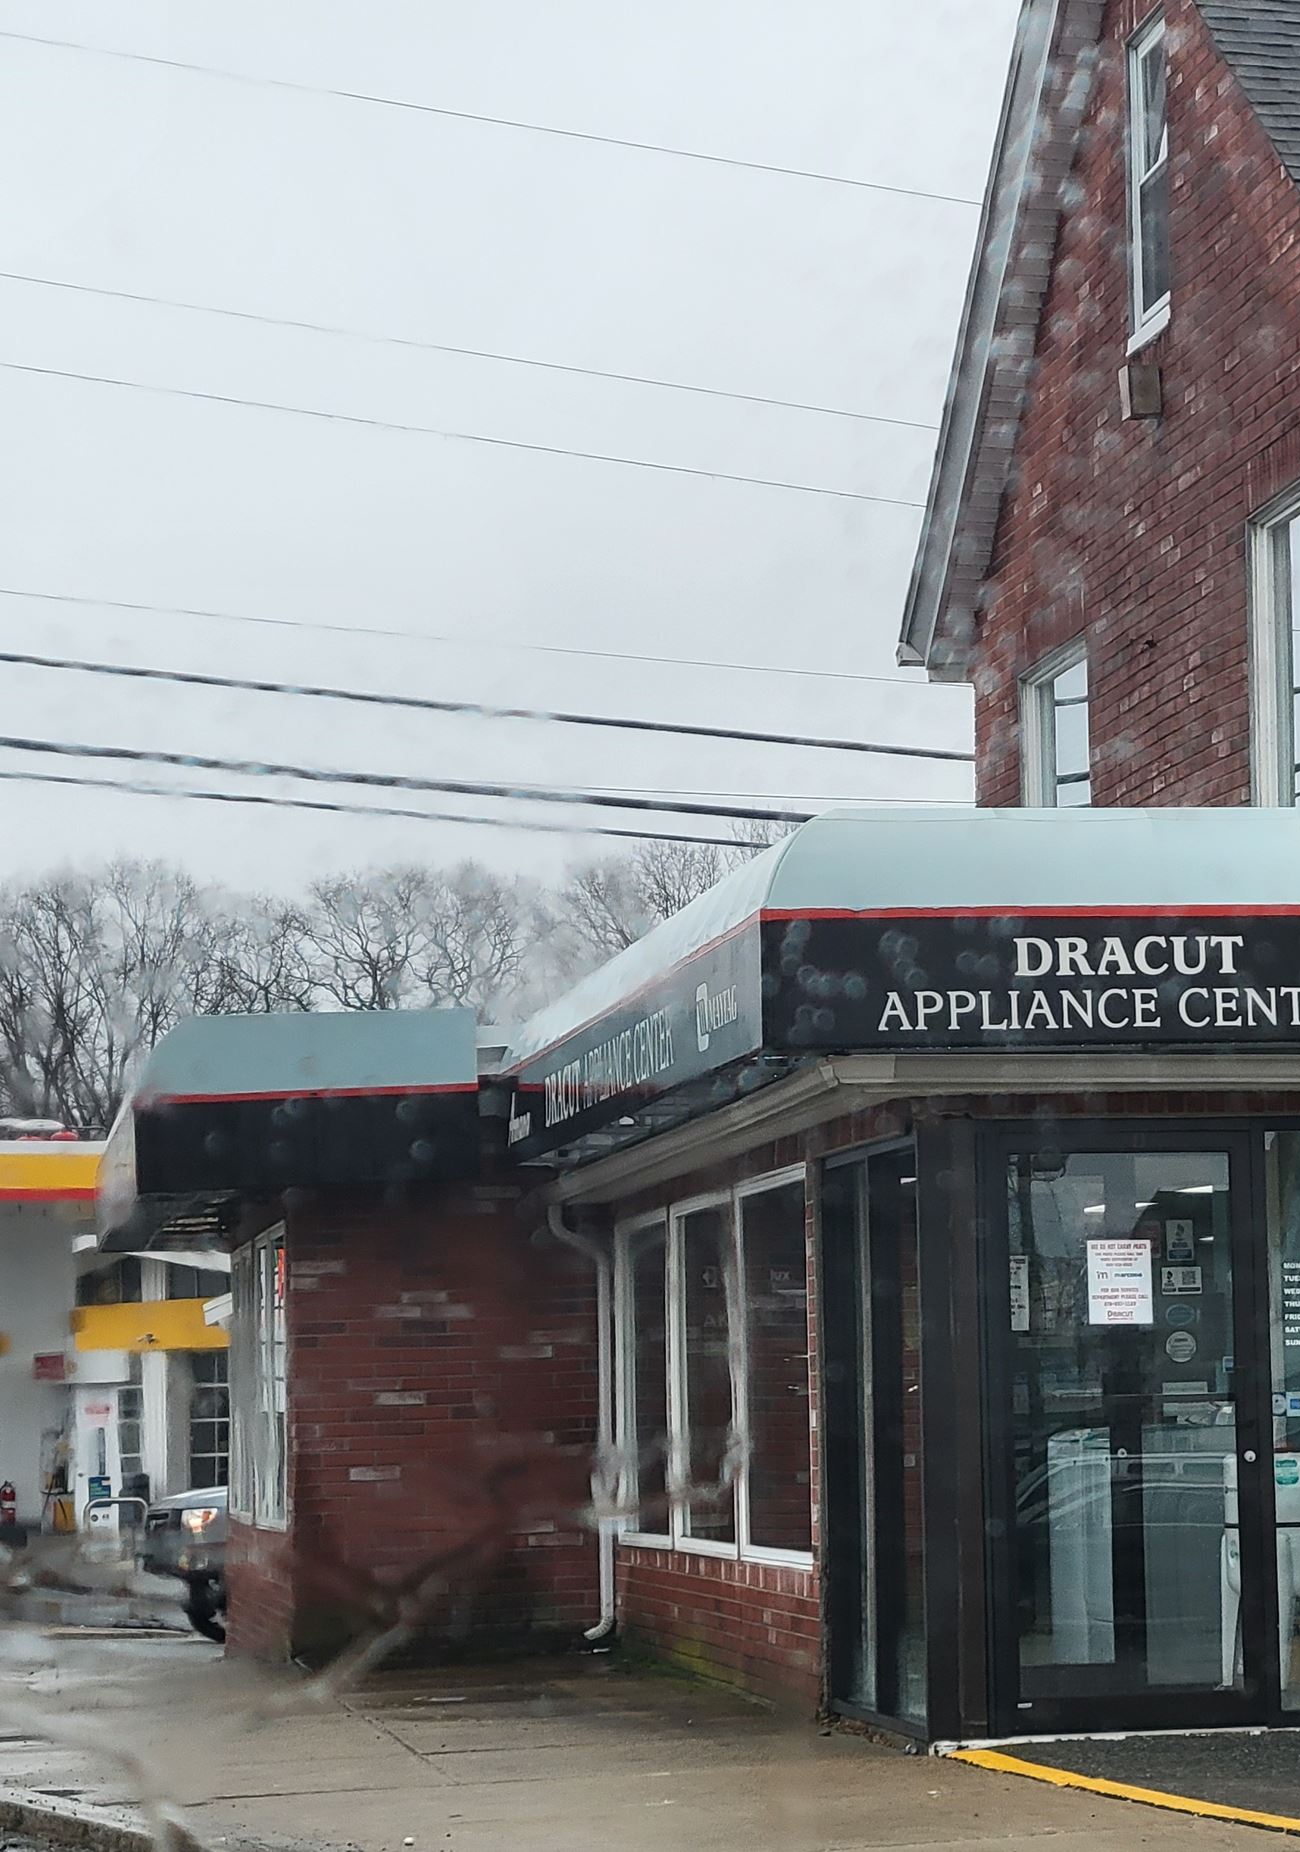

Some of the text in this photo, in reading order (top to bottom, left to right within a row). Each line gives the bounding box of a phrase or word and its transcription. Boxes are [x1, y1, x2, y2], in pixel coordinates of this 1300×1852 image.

[1014, 936, 1244, 977] DRACUT
[878, 988, 1161, 1032] APPLIANCE
[545, 1059, 580, 1128] DRACUT
[583, 1028, 632, 1110] APPLIANCE
[634, 1005, 674, 1085] CENTER
